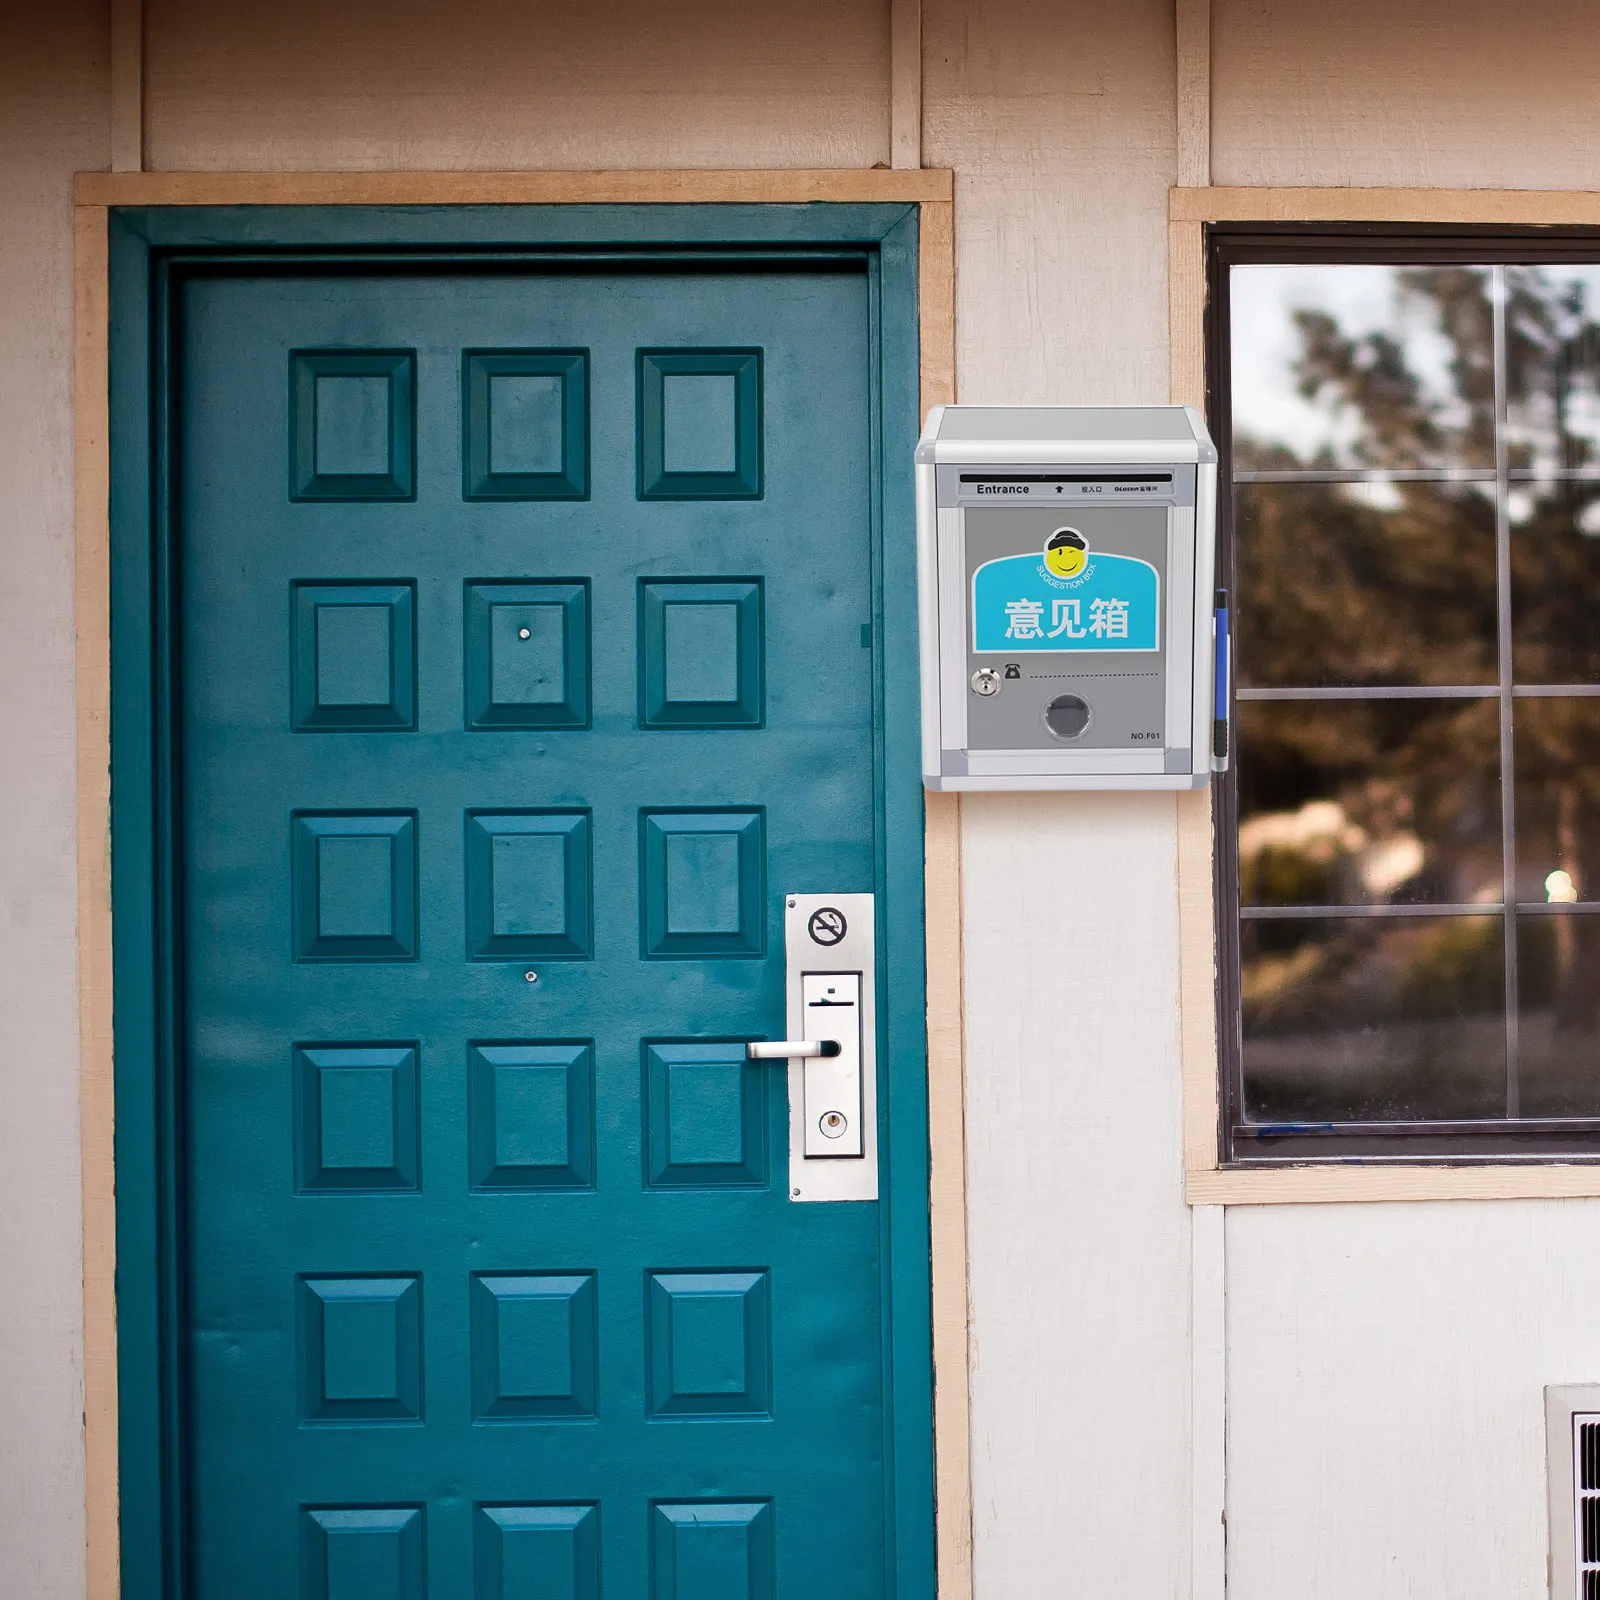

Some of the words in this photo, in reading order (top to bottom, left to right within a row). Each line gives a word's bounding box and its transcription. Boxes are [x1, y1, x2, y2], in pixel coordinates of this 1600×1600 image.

[976, 484, 1030, 495] Entrance
[1036, 565, 1085, 590] SUGGESTION
[1083, 563, 1097, 581] BOX
[1004, 597, 1130, 639] 意见箱
[1130, 732, 1161, 740] NO.F01
